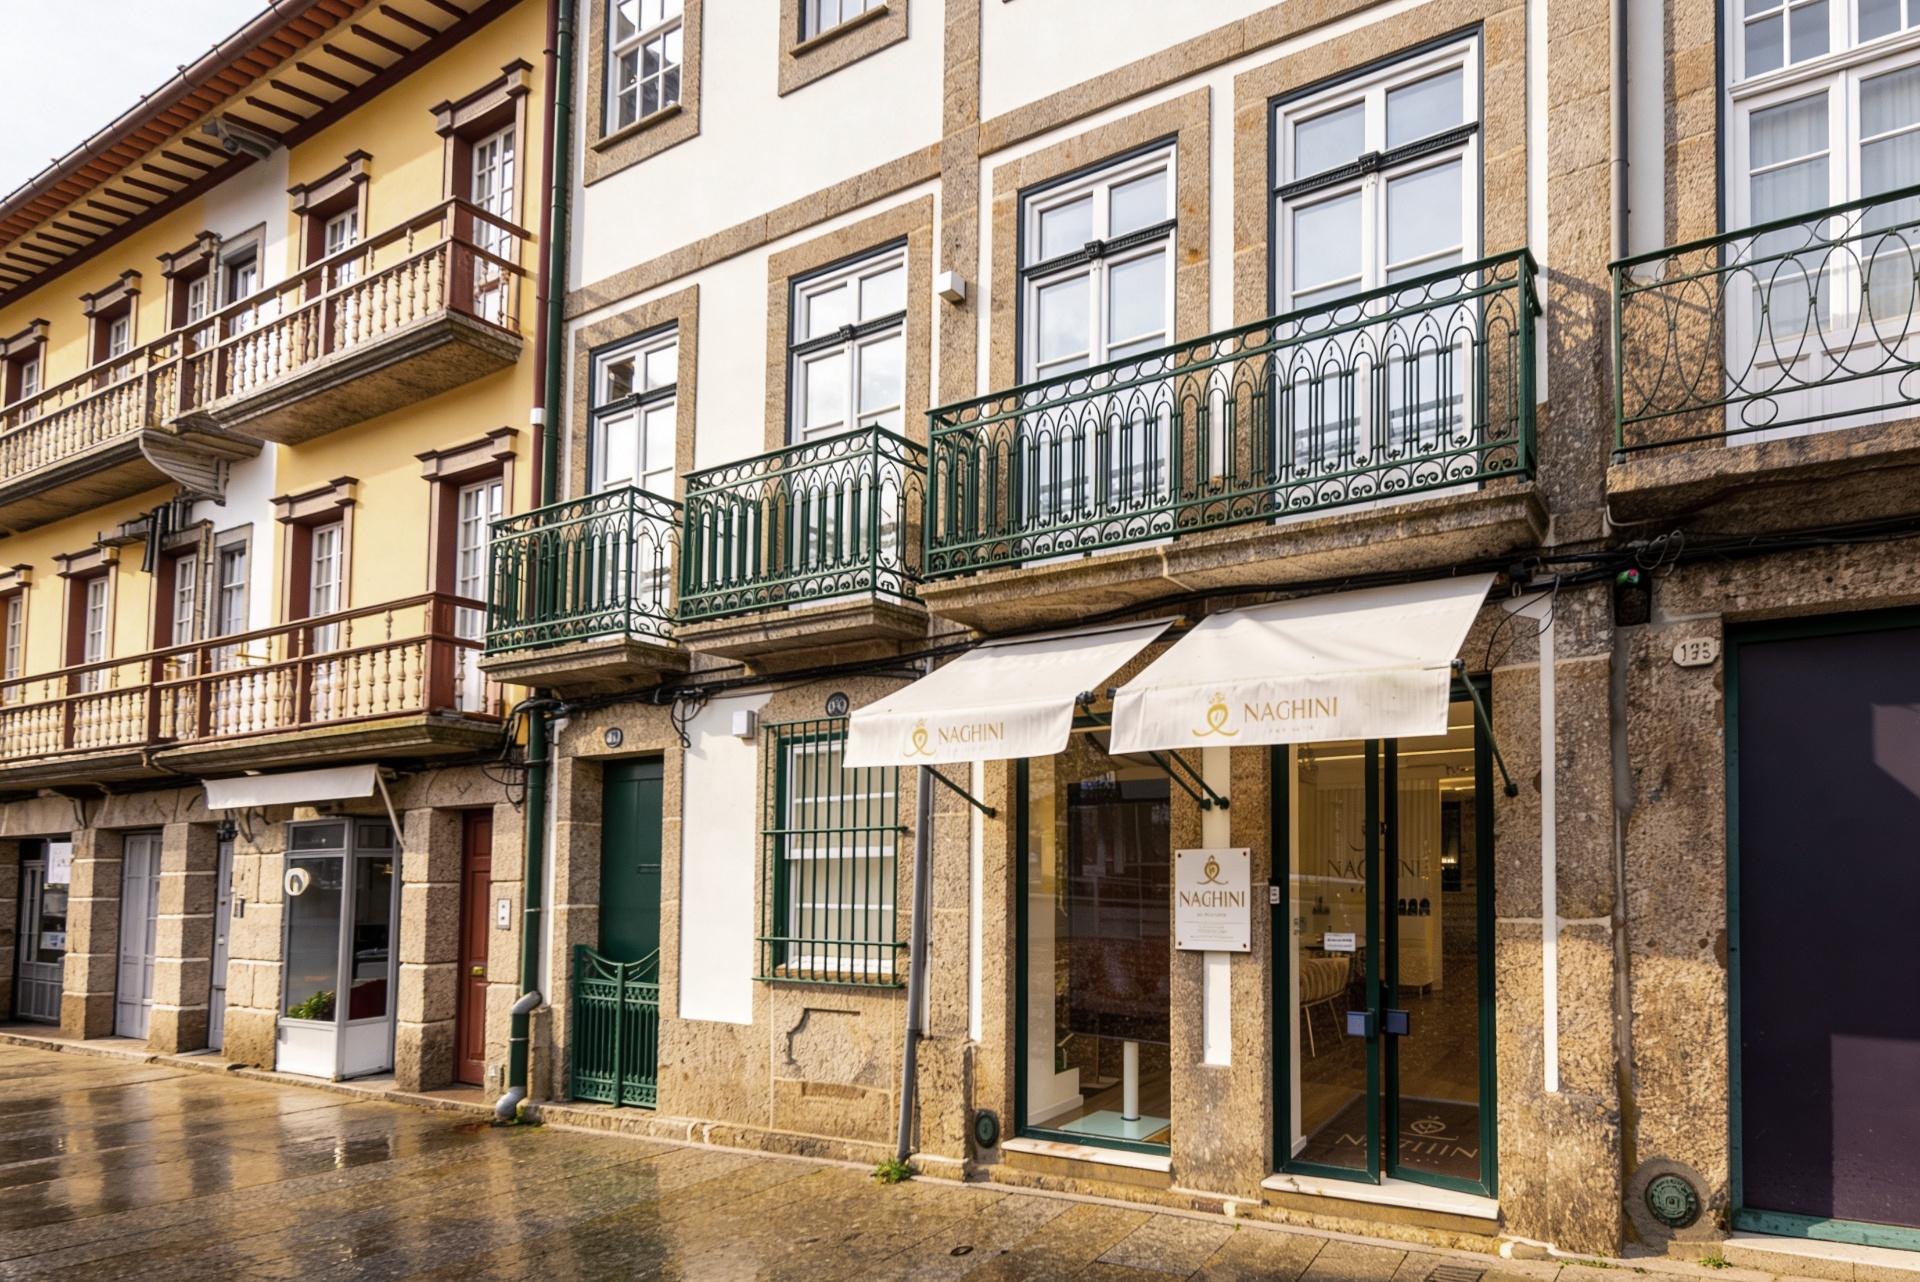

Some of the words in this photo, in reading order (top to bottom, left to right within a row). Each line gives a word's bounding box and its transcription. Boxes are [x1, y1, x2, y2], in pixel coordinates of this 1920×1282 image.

[1244, 696, 1337, 723] NAGHINI
[938, 722, 1004, 745] NAGHINI
[1179, 890, 1245, 908] NAGHINI
